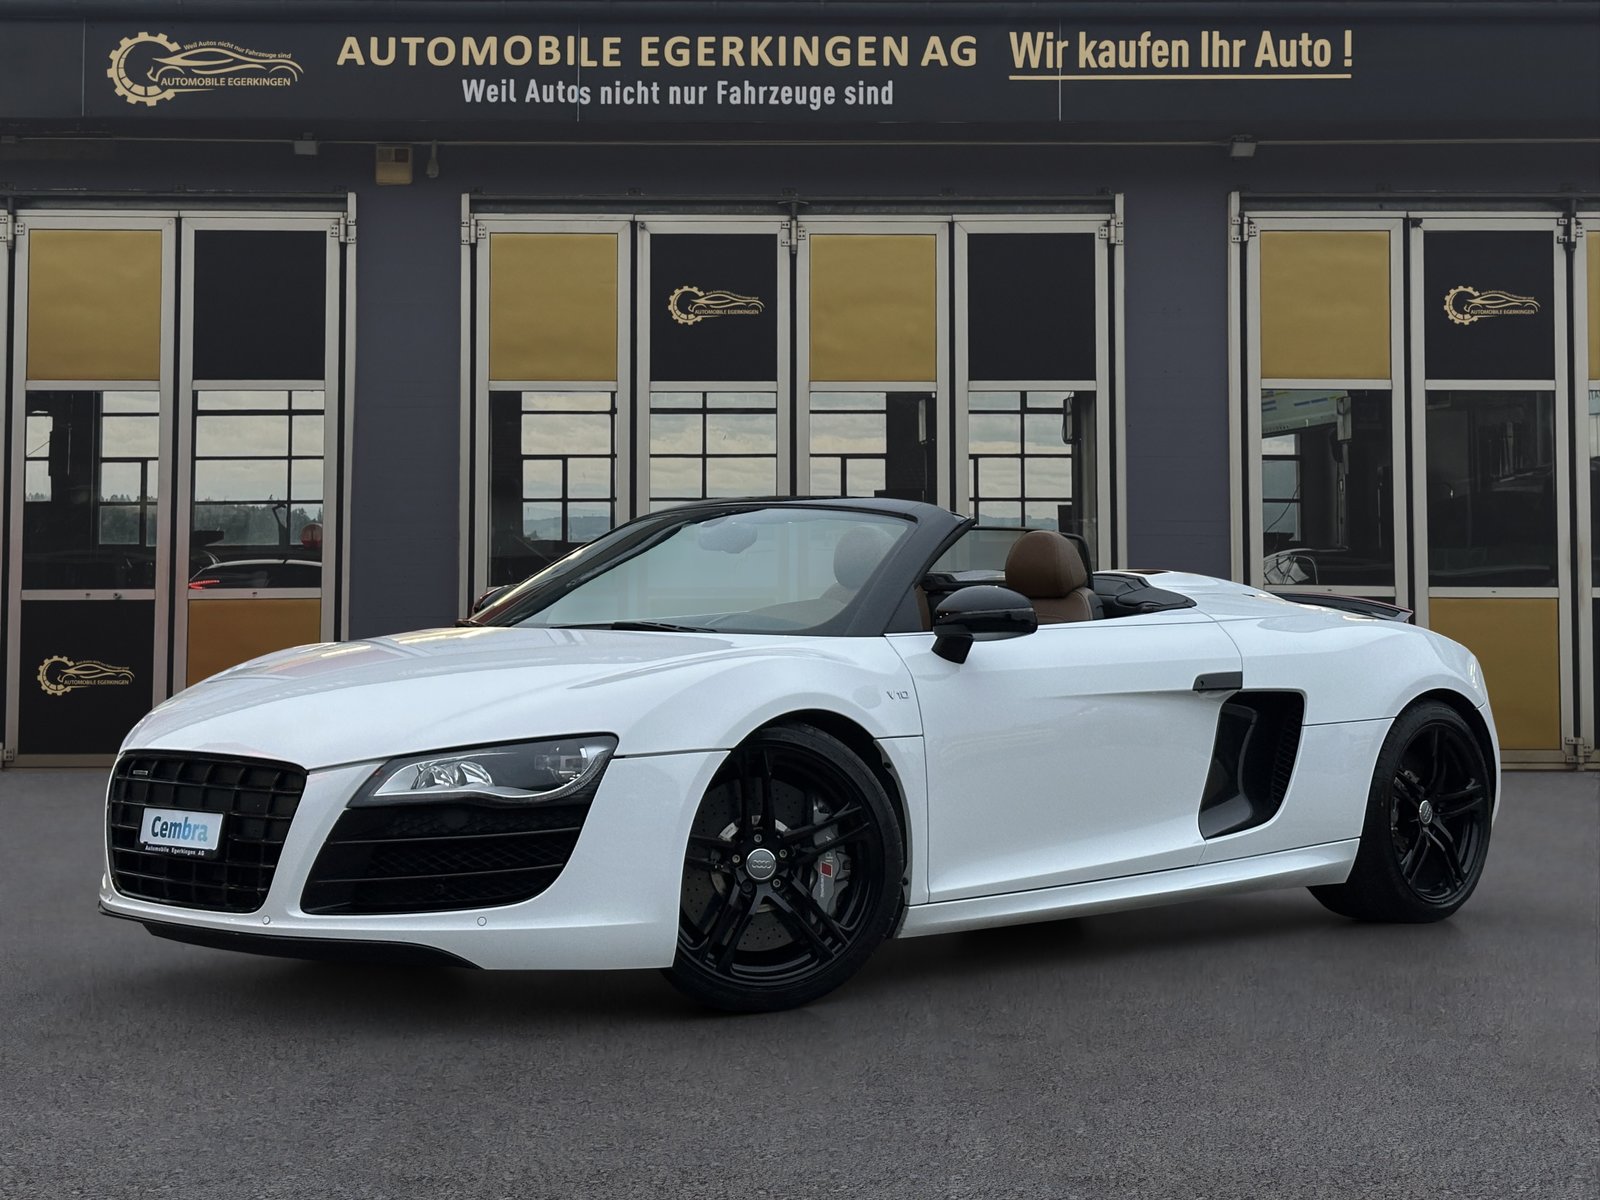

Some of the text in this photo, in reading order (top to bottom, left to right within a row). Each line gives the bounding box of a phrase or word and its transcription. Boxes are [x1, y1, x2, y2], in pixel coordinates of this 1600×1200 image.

[183, 42, 198, 50] Weil
[217, 41, 234, 49] nicht
[245, 49, 277, 59] Fahrzeuge
[337, 35, 977, 68] AUTOMOBILE EGERKINGEN AG
[1009, 31, 1069, 69] Wir
[1079, 30, 1190, 69] kaufen
[1201, 30, 1247, 68] Ihr
[1255, 30, 1332, 68] Auto
[161, 77, 291, 87] AUTOMOBILE EGERKINGEN
[462, 79, 893, 110] Weil Autos nicht nur Fahrzeuge sind
[151, 816, 208, 842] Cembra
